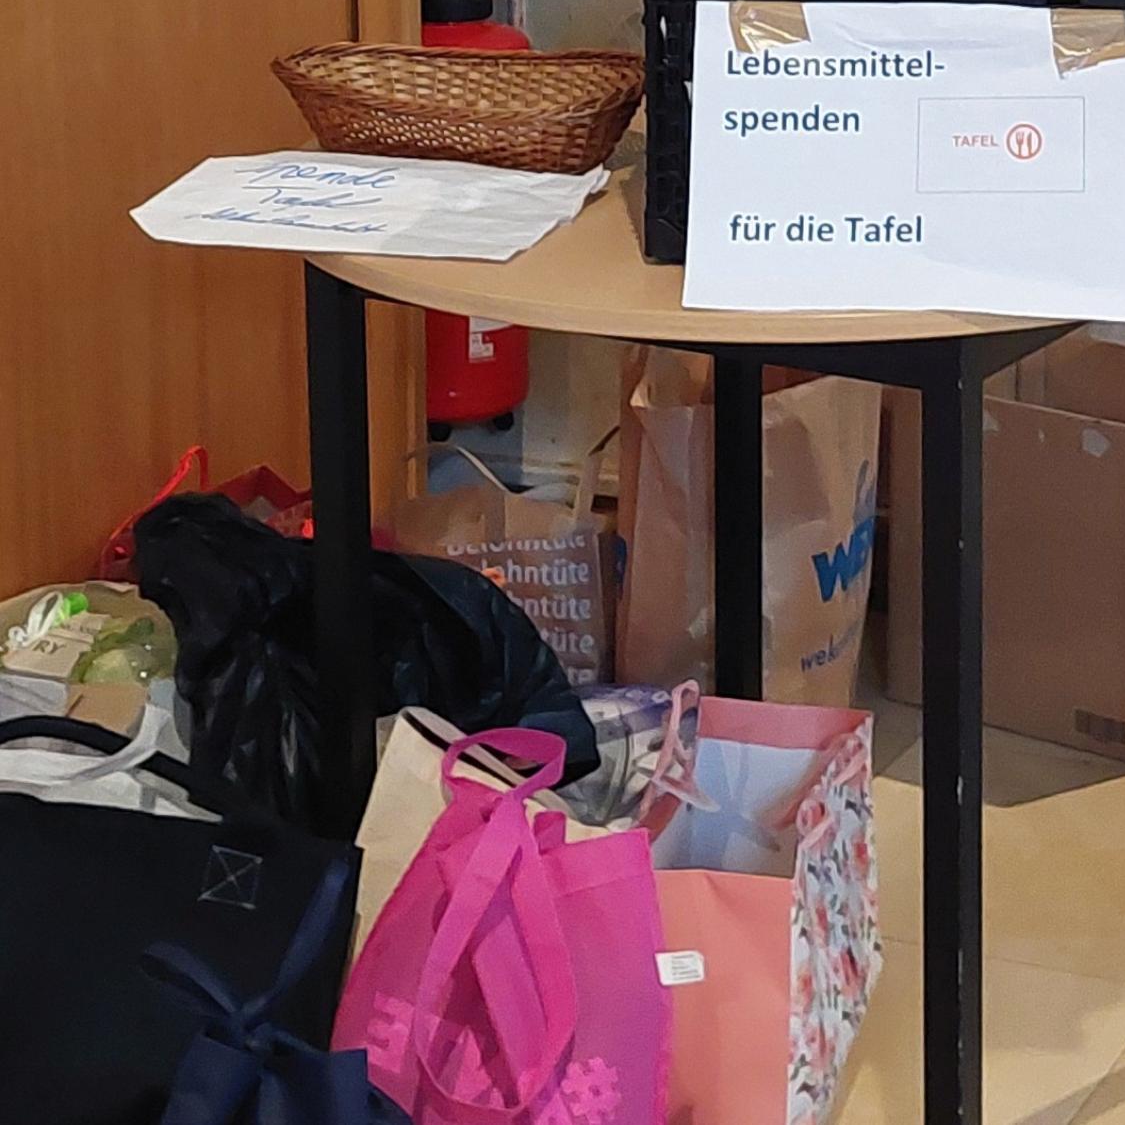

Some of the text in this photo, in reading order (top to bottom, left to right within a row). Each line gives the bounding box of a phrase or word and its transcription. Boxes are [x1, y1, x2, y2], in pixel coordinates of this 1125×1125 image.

[727, 51, 944, 77] Lebensmittel-
[724, 104, 860, 137] spenden
[953, 135, 998, 148] TAFEL
[730, 215, 923, 243] für die Tafel
